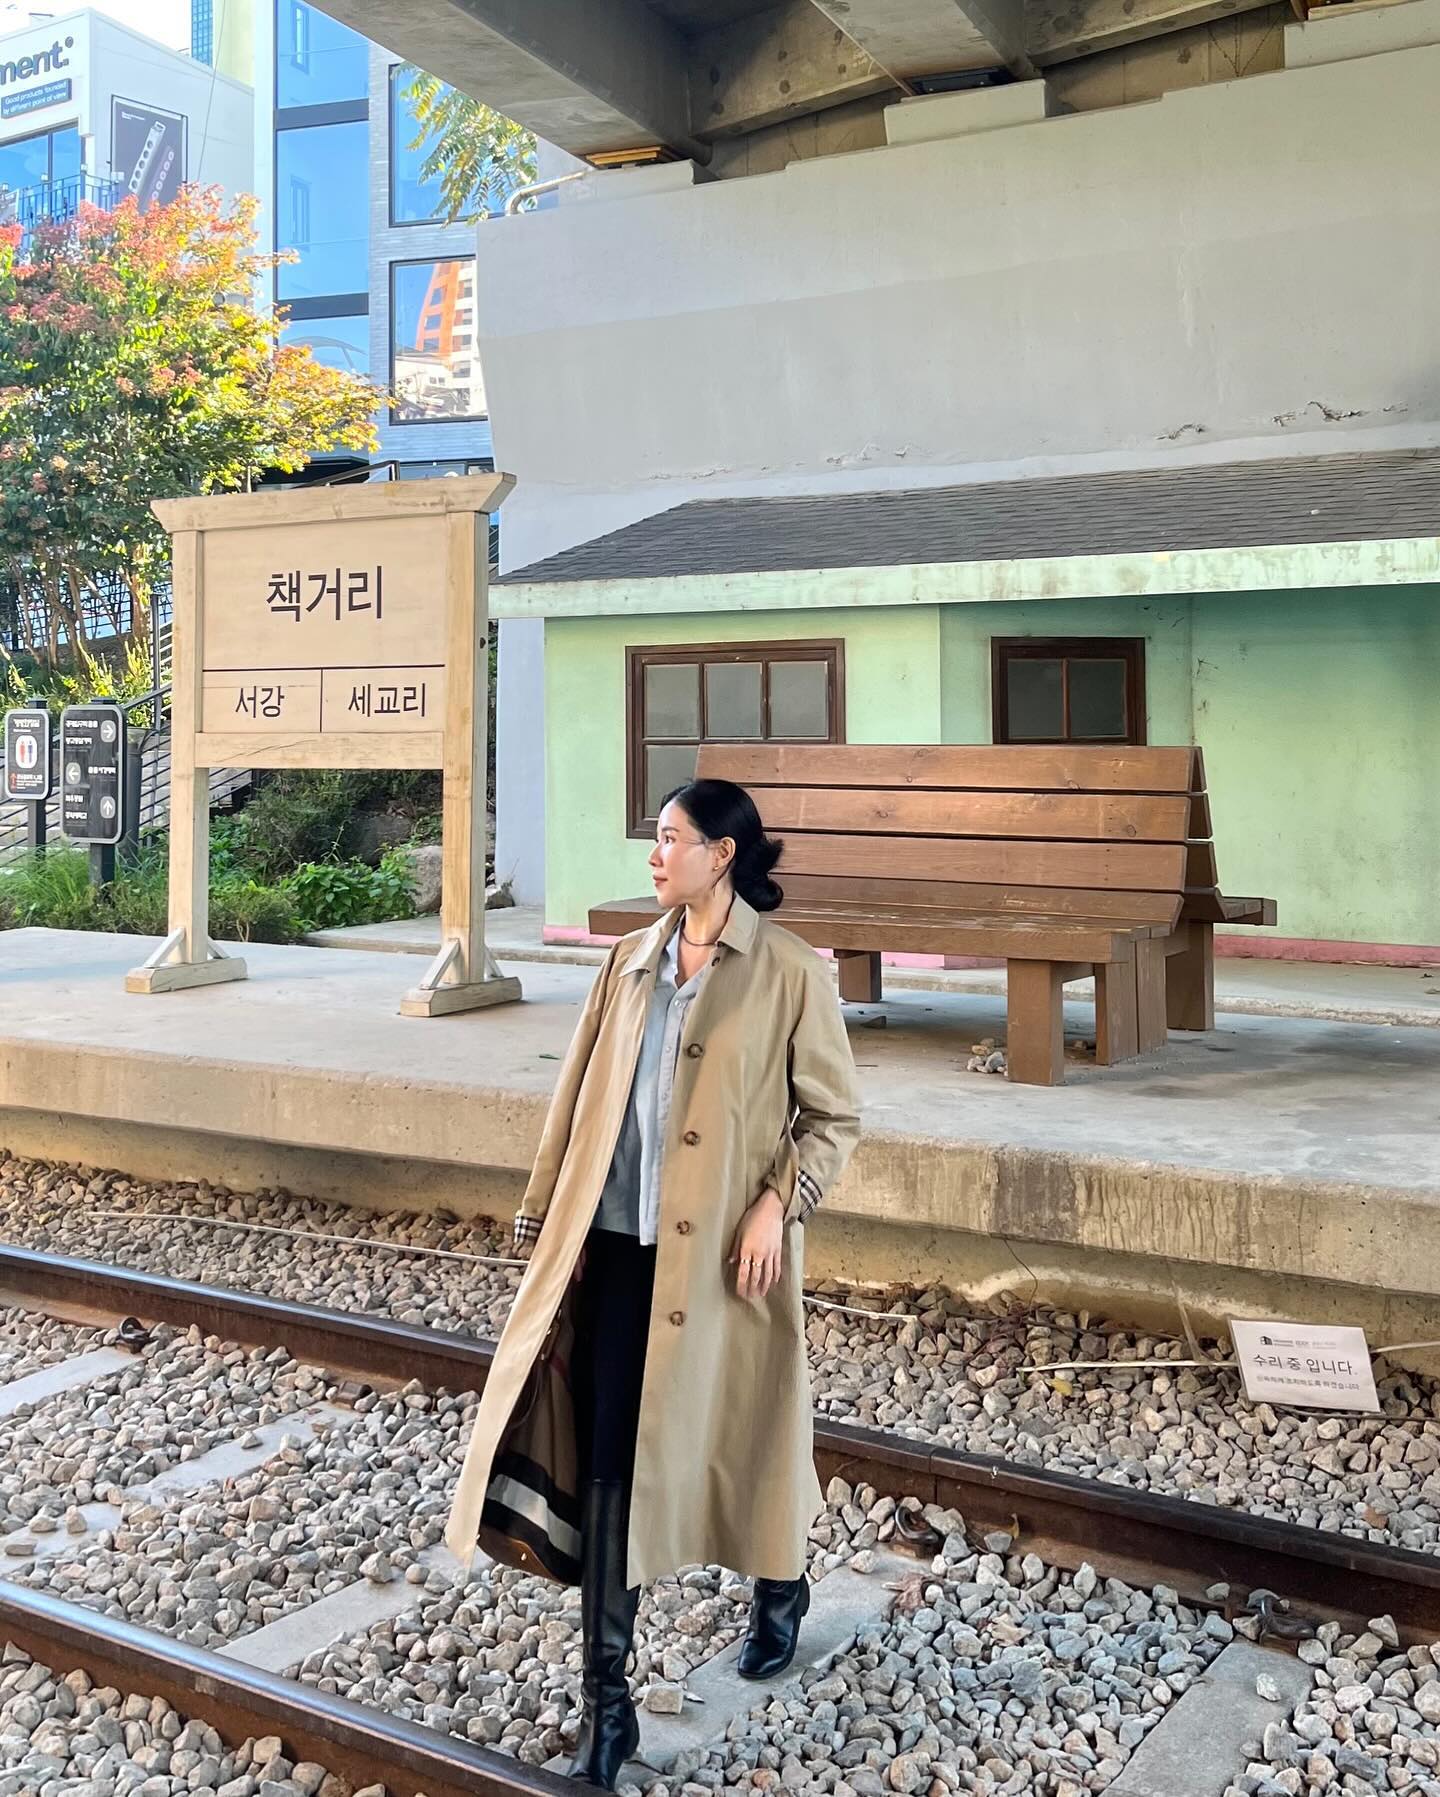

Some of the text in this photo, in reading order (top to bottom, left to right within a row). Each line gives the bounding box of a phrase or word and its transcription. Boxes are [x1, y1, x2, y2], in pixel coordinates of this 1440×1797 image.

[5, 94, 20, 105] Good
[266, 565, 383, 622] 책거리
[235, 685, 285, 718] 서강
[348, 682, 426, 717] 세교리
[1253, 1354, 1283, 1369] 수리
[1287, 1357, 1301, 1371] 중
